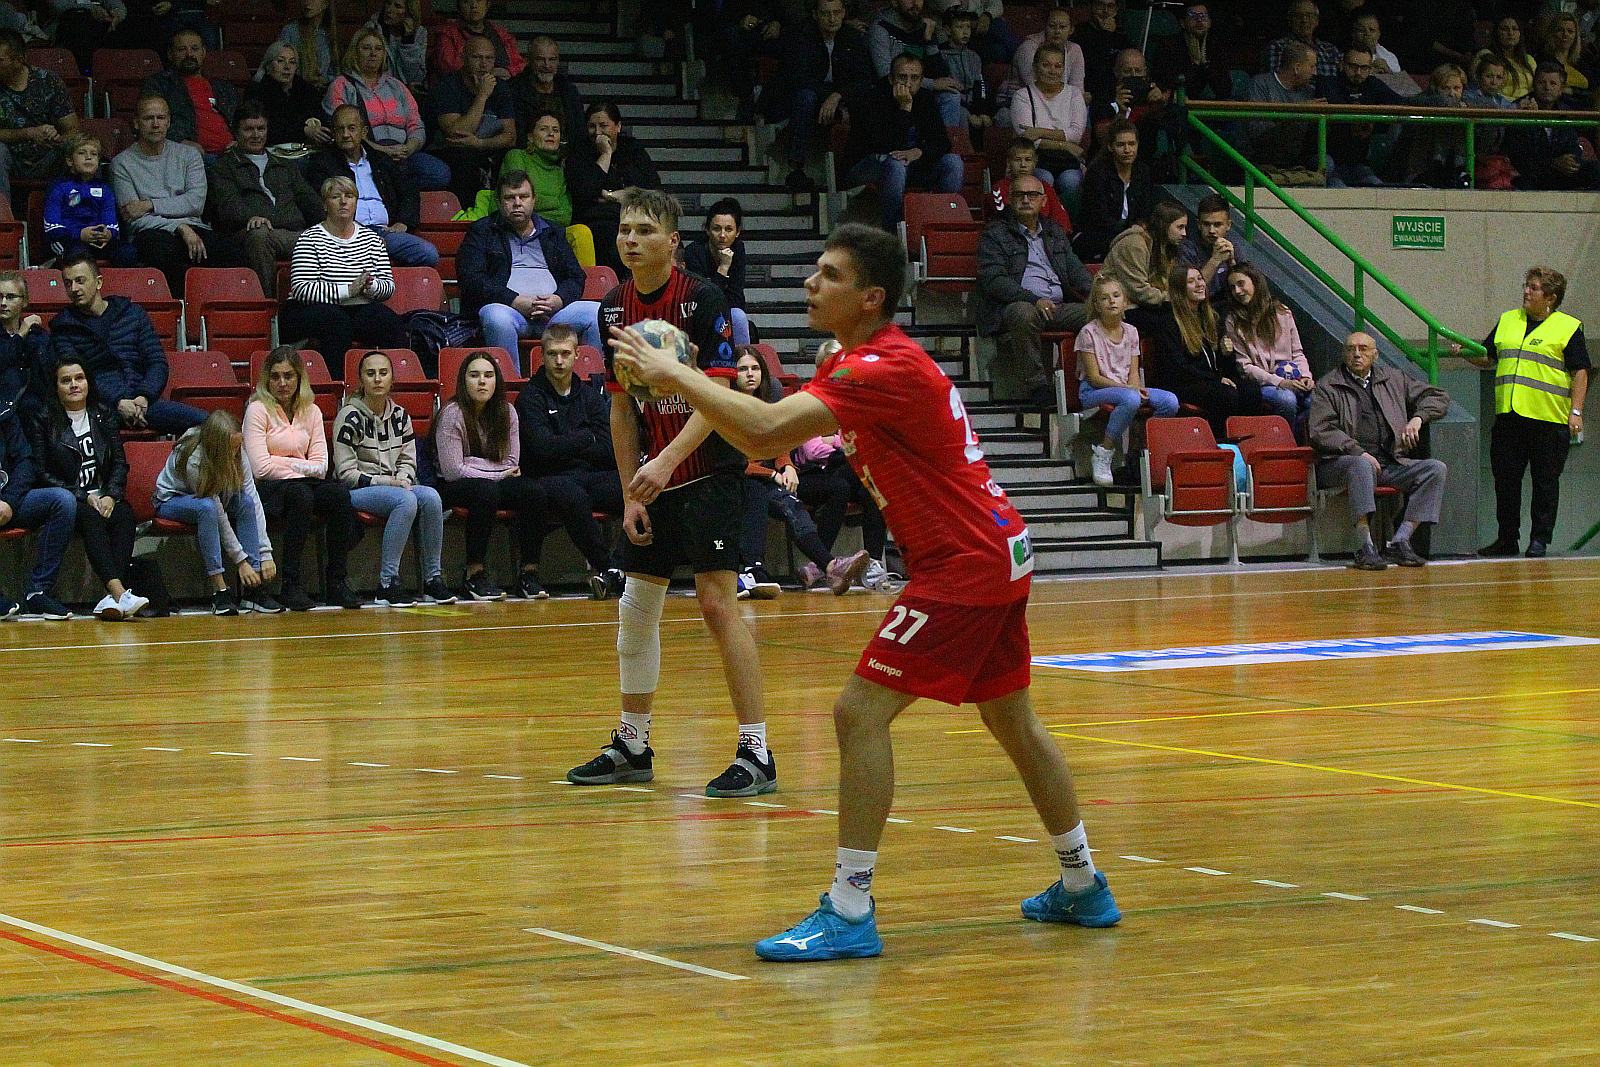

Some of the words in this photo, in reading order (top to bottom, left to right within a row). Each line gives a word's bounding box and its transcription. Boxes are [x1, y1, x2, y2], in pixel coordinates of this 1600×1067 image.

[604, 313, 618, 323] ZAP
[879, 605, 929, 645] 27
[867, 657, 903, 677] Kempa
